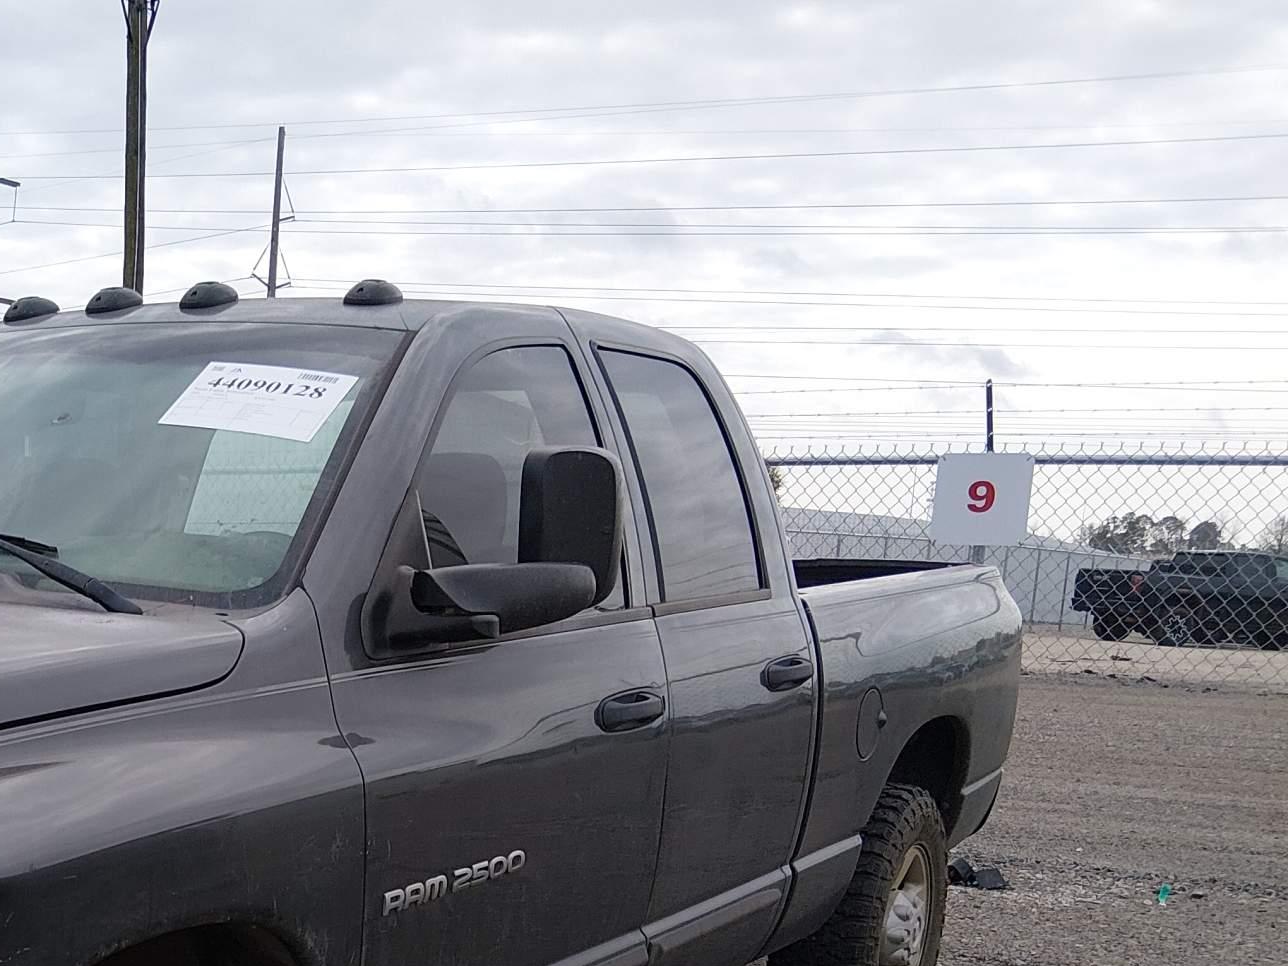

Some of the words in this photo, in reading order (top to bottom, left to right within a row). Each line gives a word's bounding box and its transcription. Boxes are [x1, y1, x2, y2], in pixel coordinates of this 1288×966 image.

[208, 376, 327, 399] 44090128
[967, 480, 996, 513] 9
[383, 874, 448, 916] RAM
[452, 849, 526, 893] 2500
